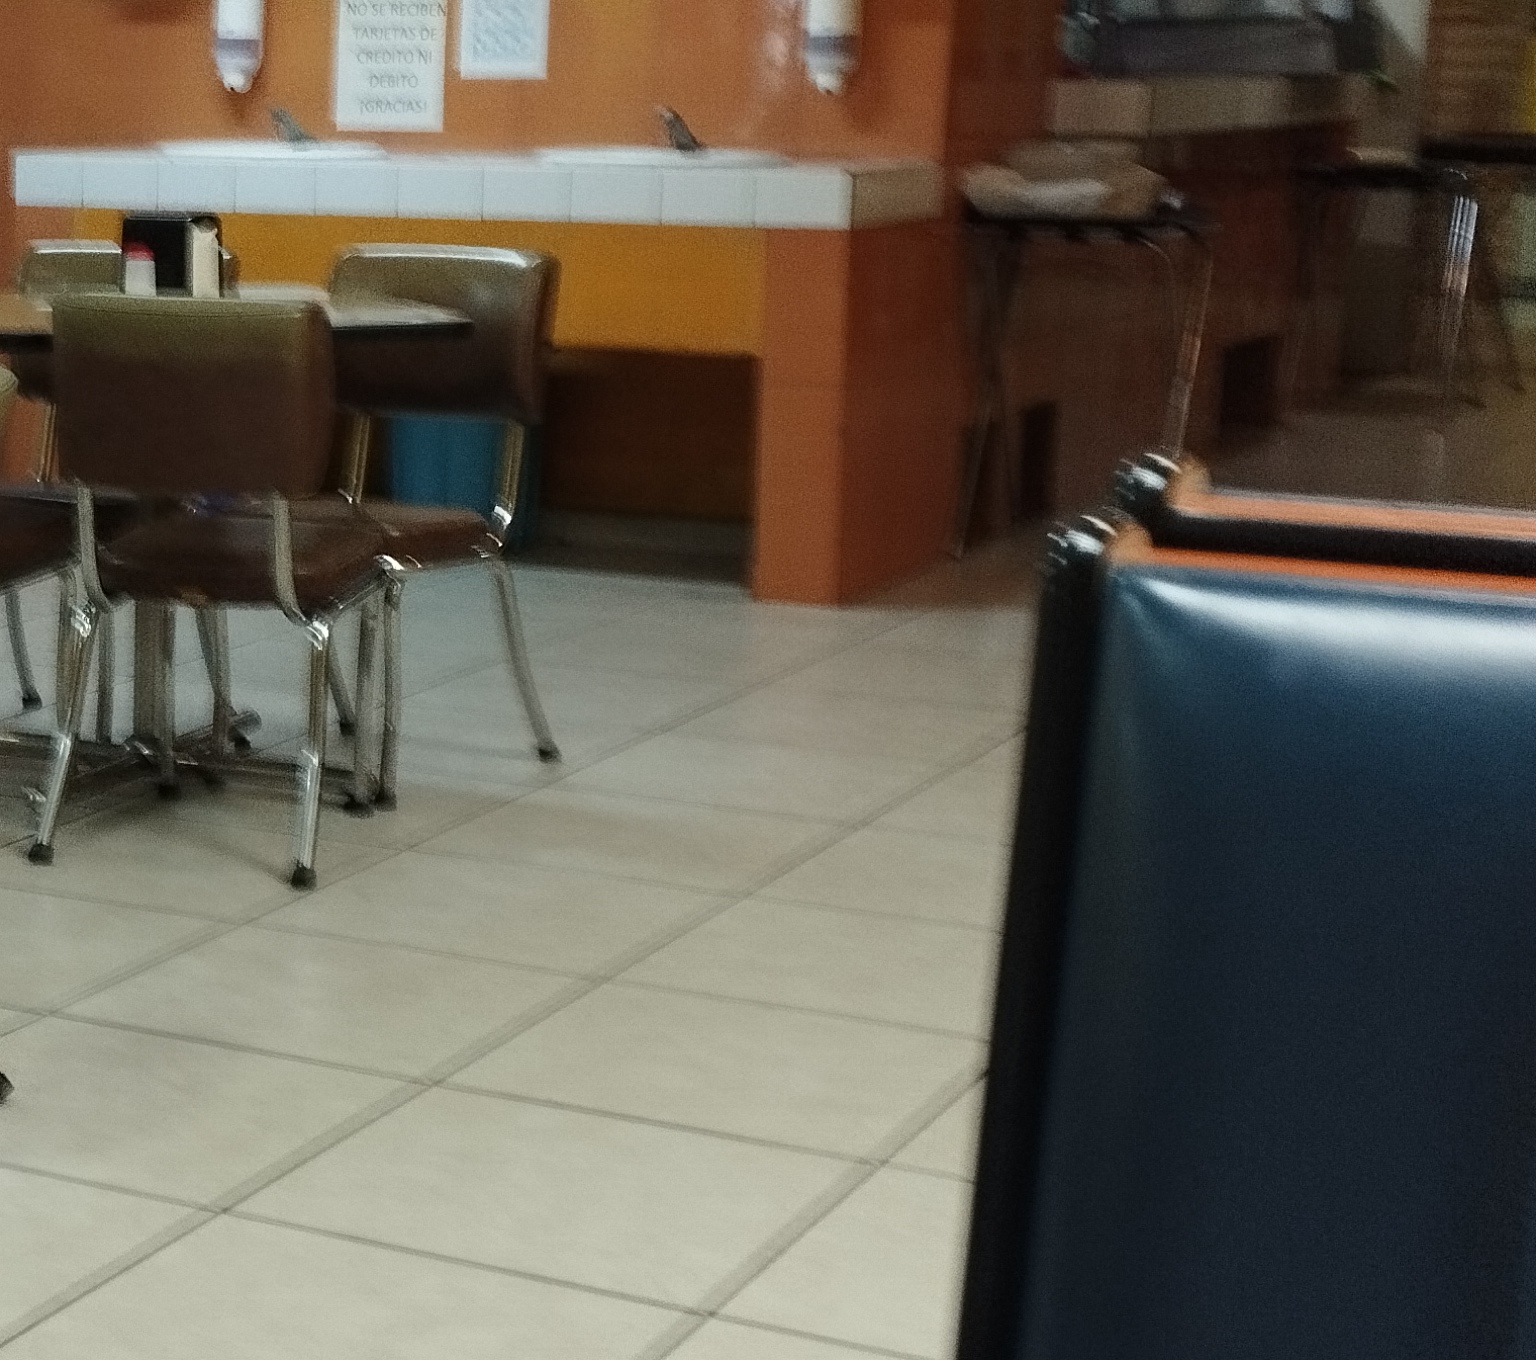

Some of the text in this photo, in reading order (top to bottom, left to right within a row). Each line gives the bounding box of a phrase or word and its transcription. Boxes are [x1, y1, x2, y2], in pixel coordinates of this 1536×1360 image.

[347, 2, 447, 17] NO SE RECIBEN
[352, 26, 438, 41] TARJETAS DE
[356, 48, 433, 65] CREDITO NI
[368, 73, 419, 89] DEBITO
[359, 99, 428, 115] ¡GRACIAS!
